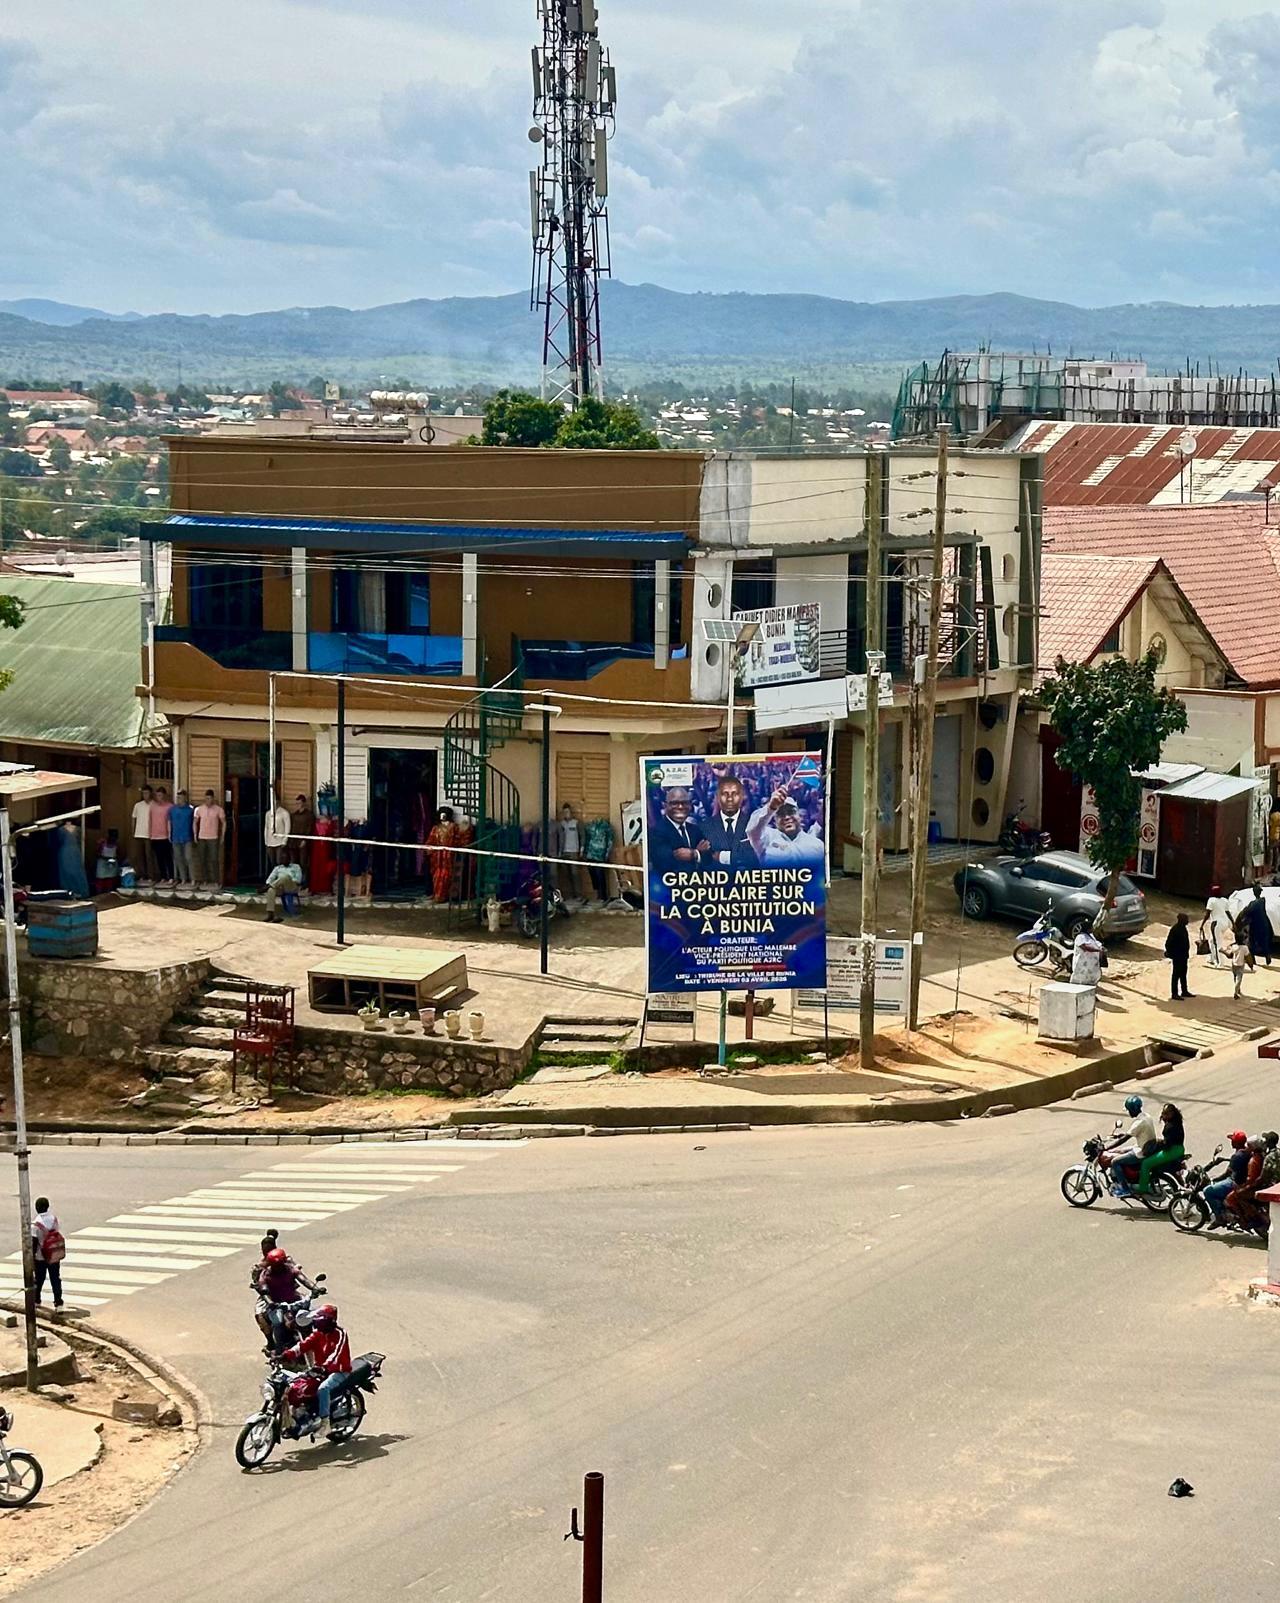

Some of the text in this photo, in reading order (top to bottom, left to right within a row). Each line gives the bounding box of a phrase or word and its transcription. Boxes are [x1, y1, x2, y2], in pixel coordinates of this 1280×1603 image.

[766, 623, 786, 638] BUNIA
[662, 868, 813, 887] GRAND MEETING
[671, 885, 804, 902] POPULAIRE SUR
[660, 901, 815, 919] LA CONSTITUTION
[701, 917, 775, 934] À BUNIA
[748, 950, 783, 958] NATIONAL
